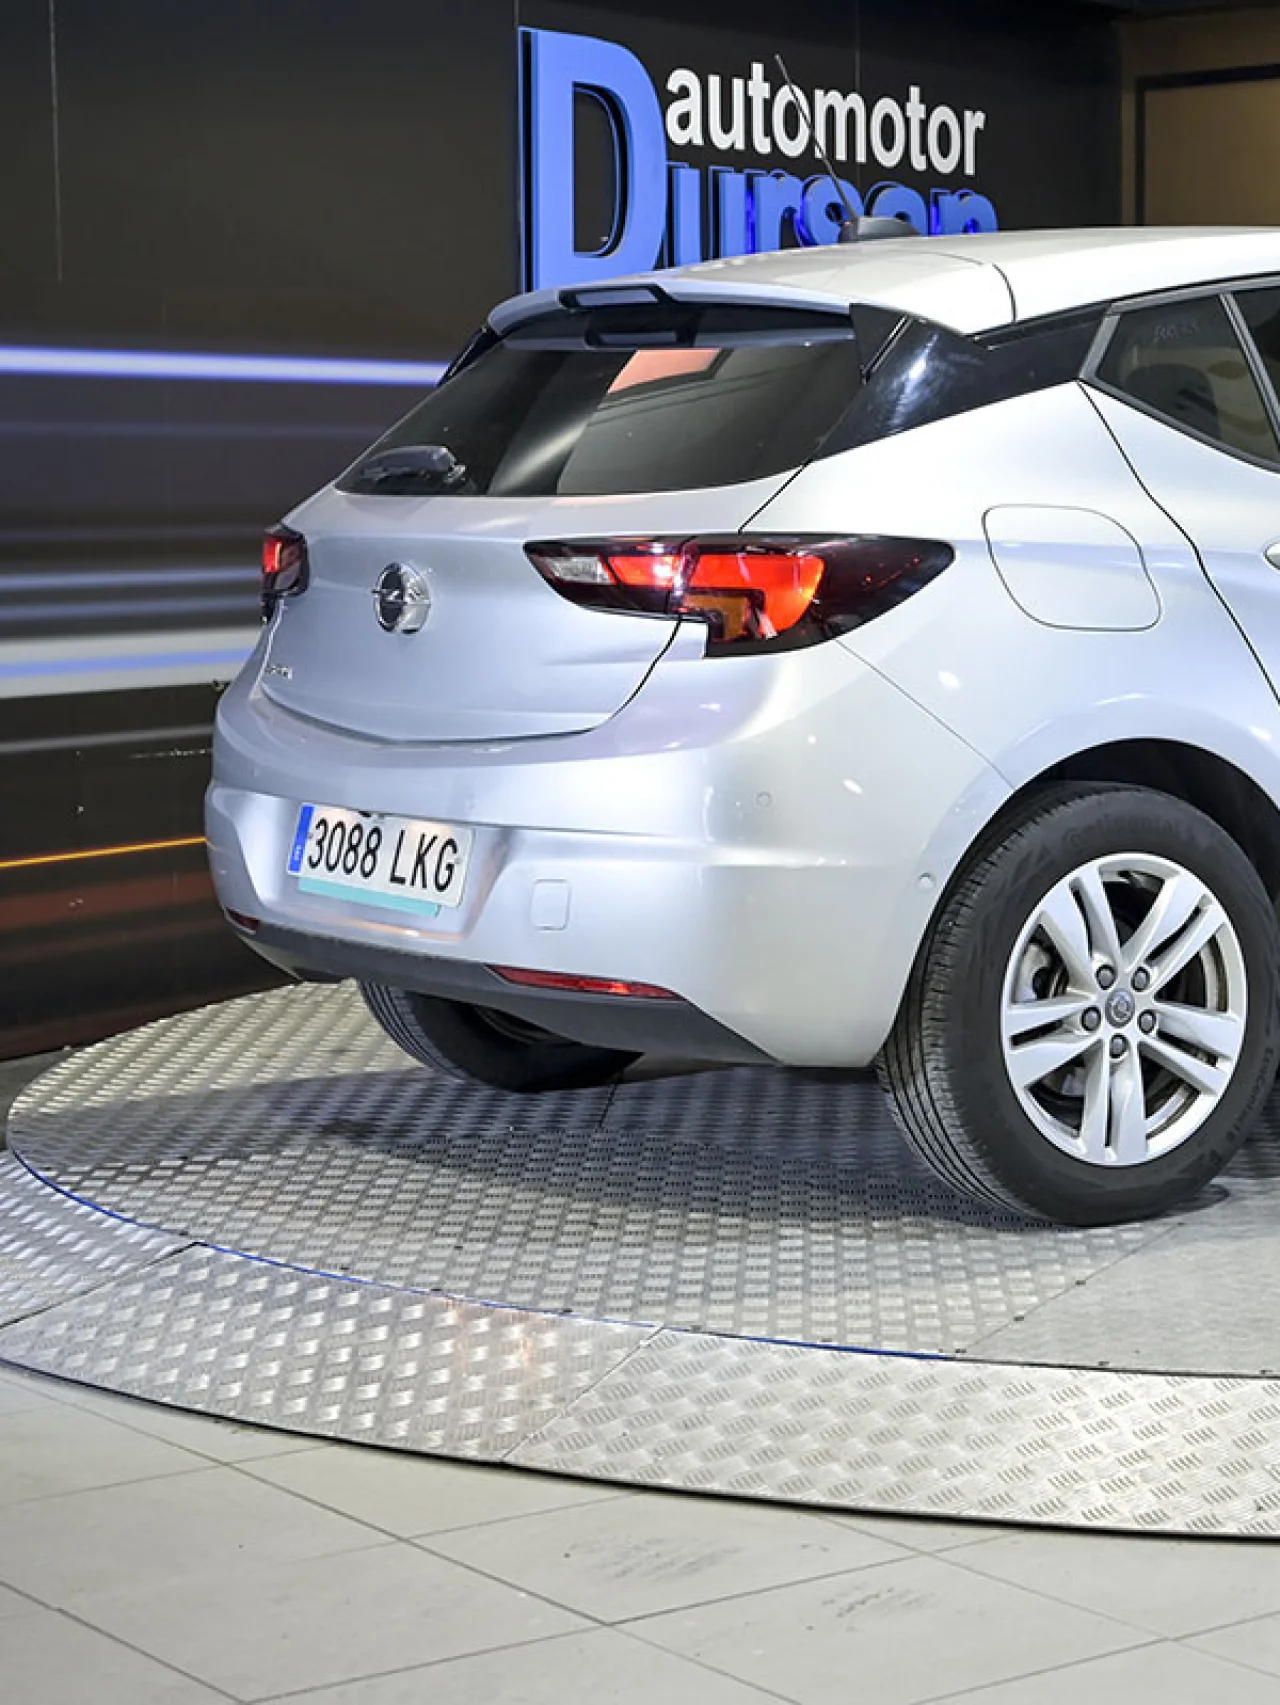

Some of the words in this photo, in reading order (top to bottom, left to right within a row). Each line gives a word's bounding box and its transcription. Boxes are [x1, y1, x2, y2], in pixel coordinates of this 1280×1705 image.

[666, 62, 987, 176] automotor
[308, 818, 382, 878] 3088
[390, 829, 458, 892] LKG
